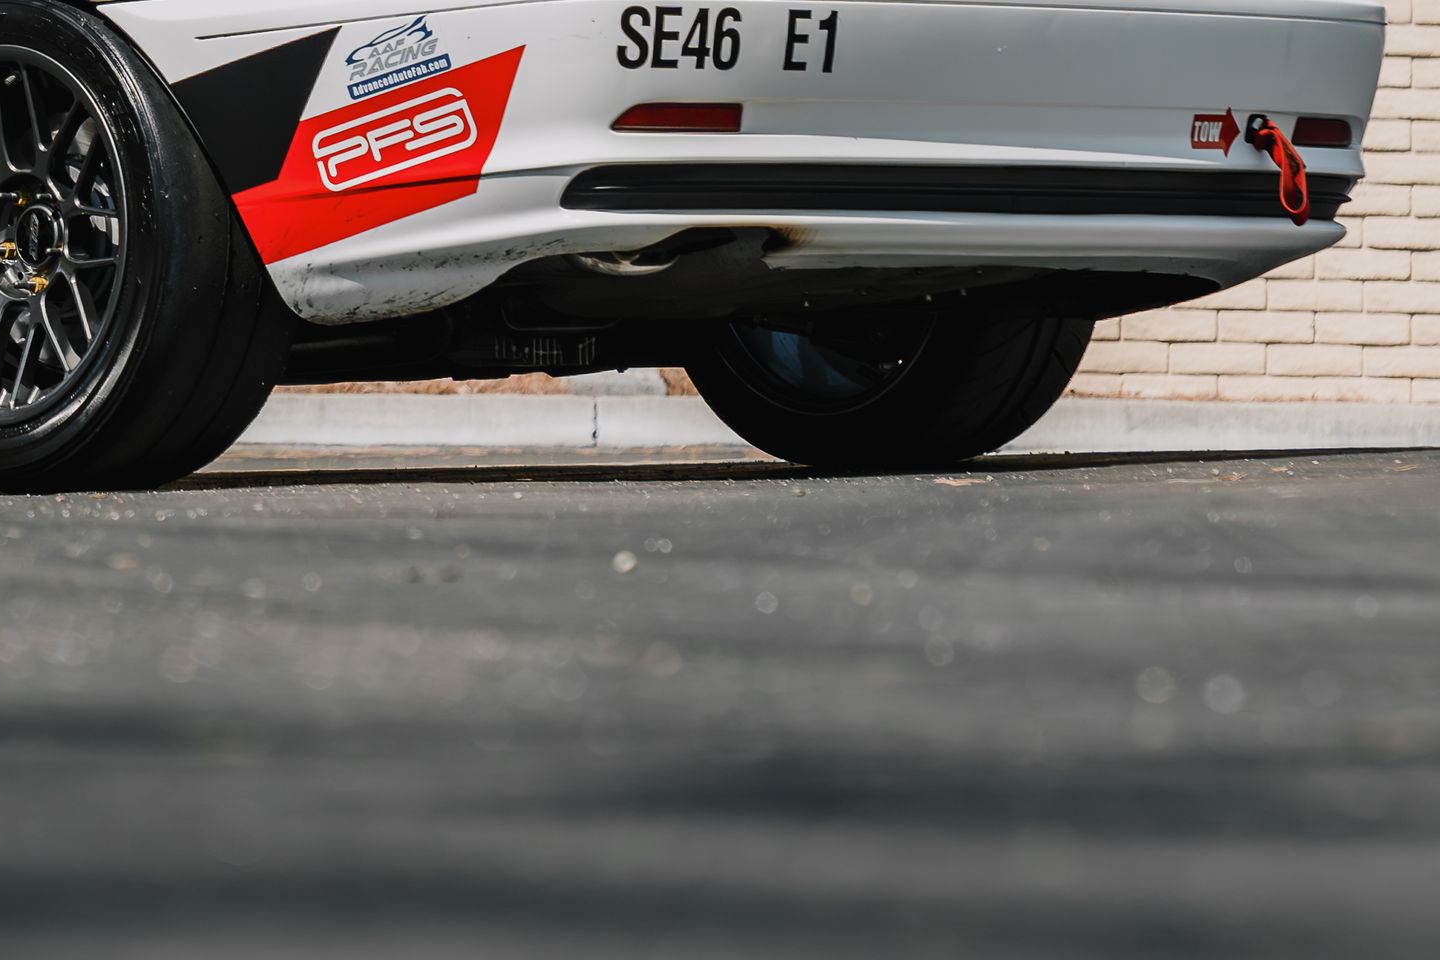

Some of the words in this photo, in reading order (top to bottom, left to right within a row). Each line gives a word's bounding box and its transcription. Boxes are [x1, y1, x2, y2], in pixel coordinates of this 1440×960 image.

[349, 37, 439, 82] RACING
[367, 38, 406, 60] AAF
[616, 5, 742, 72] SE46
[782, 8, 840, 74] E1
[352, 58, 449, 97] AdvancedAutoFab.com
[314, 98, 467, 178] PFS
[1193, 121, 1223, 142] TOW
